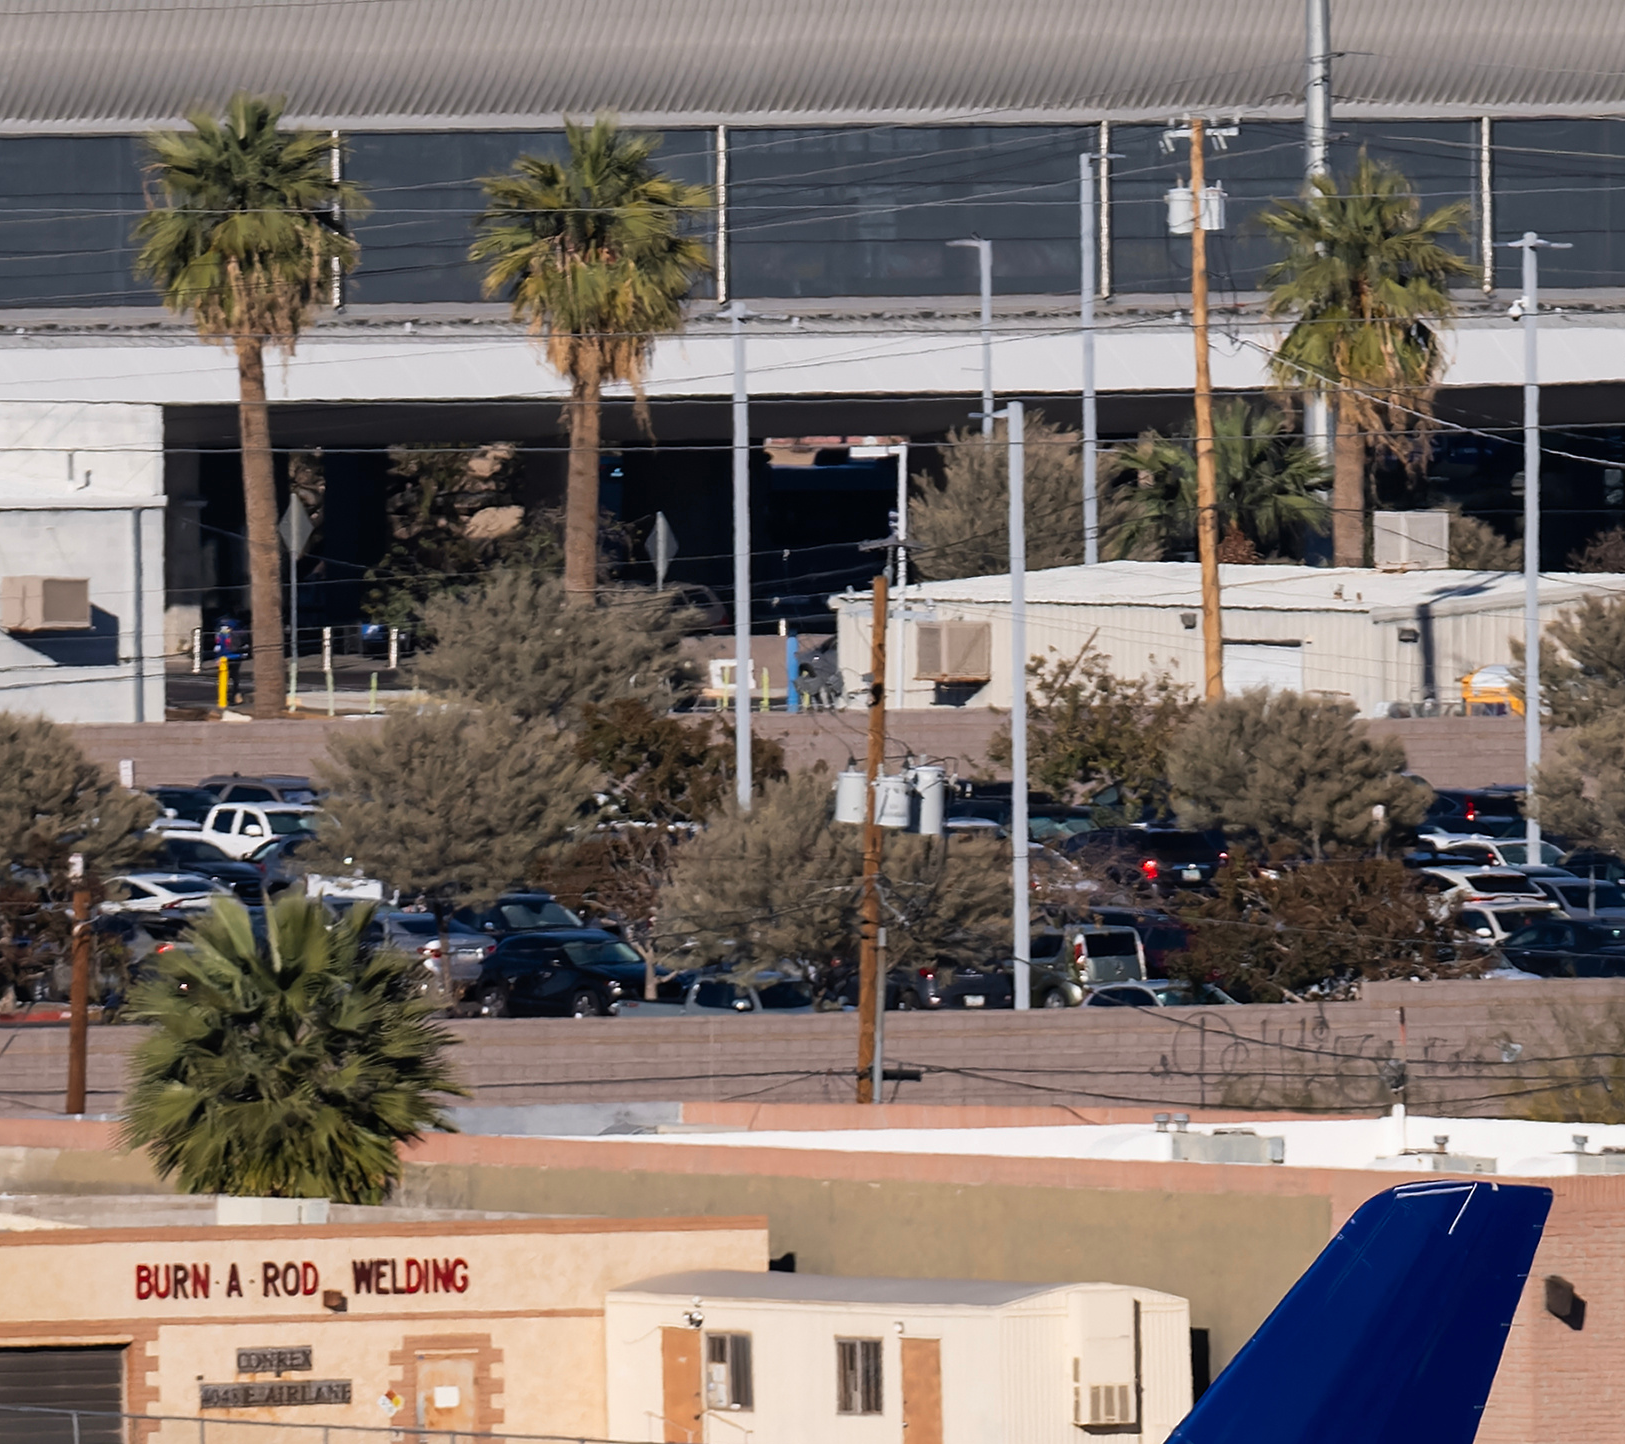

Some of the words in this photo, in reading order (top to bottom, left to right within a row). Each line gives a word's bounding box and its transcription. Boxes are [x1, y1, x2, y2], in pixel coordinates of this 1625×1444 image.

[135, 1263, 211, 1301] BURN
[226, 1262, 244, 1298] A
[261, 1260, 320, 1298] ROD
[351, 1257, 470, 1295] WELDING
